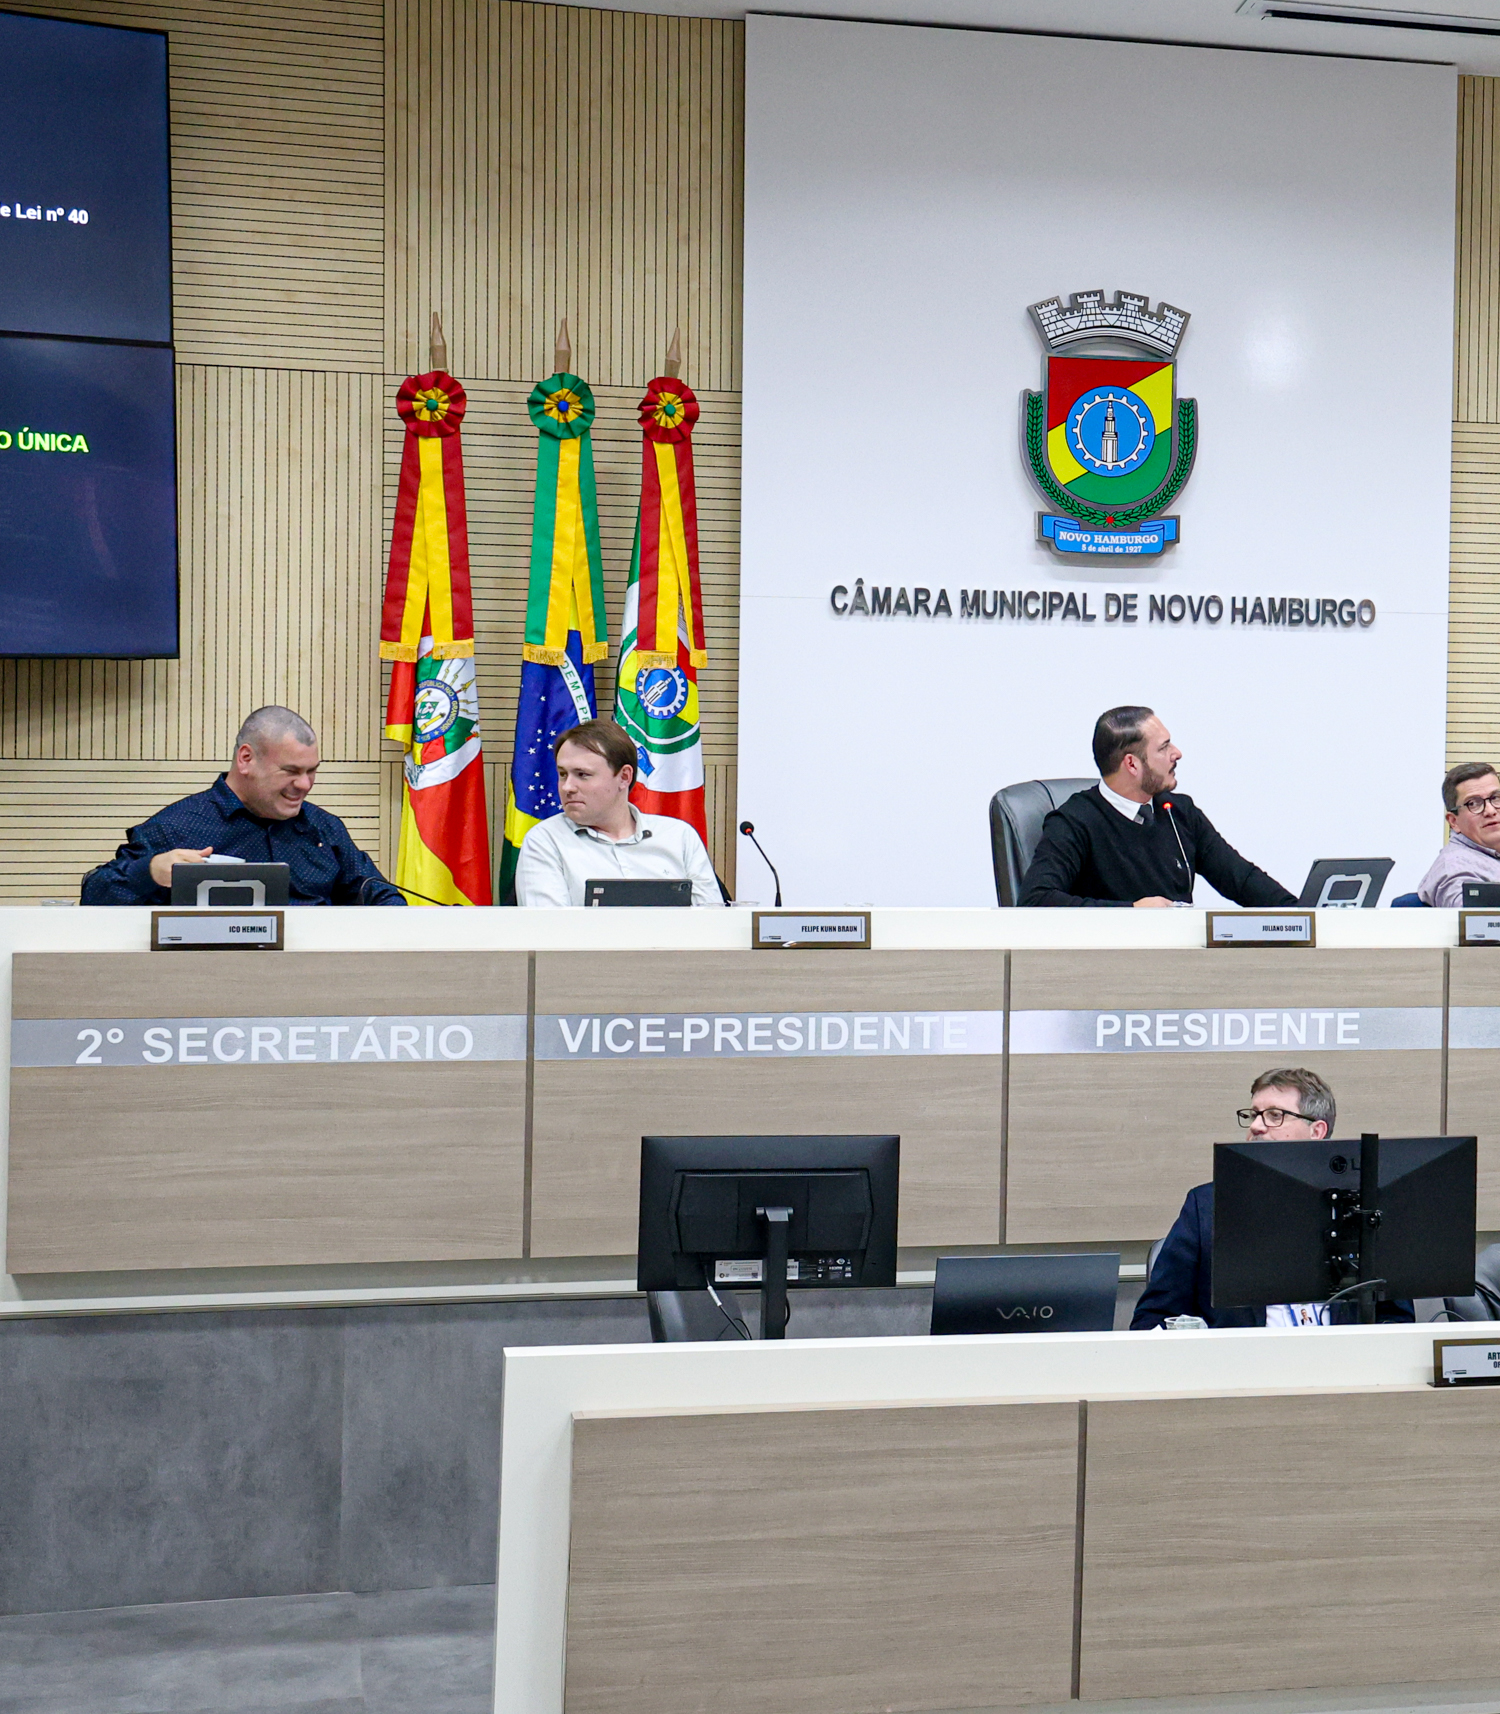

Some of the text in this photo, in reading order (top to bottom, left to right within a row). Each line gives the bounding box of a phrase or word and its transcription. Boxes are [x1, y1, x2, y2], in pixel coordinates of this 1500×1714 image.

[15, 203, 89, 225] Lei nº 40
[17, 426, 89, 453] ÚNICA
[1058, 530, 1158, 545] NOVO HAMBURGO
[1081, 542, 1142, 554] 5 de abril de 1927
[831, 578, 1375, 627] CÂMARA MUNICIPAL DE NOVO HAMBURGO
[141, 1017, 475, 1065] SECRETÁRIO
[557, 1016, 969, 1054] VICE-PRESIDENTE
[1096, 1012, 1361, 1048] PRESIDENTE
[996, 1304, 1054, 1320] VAIO
